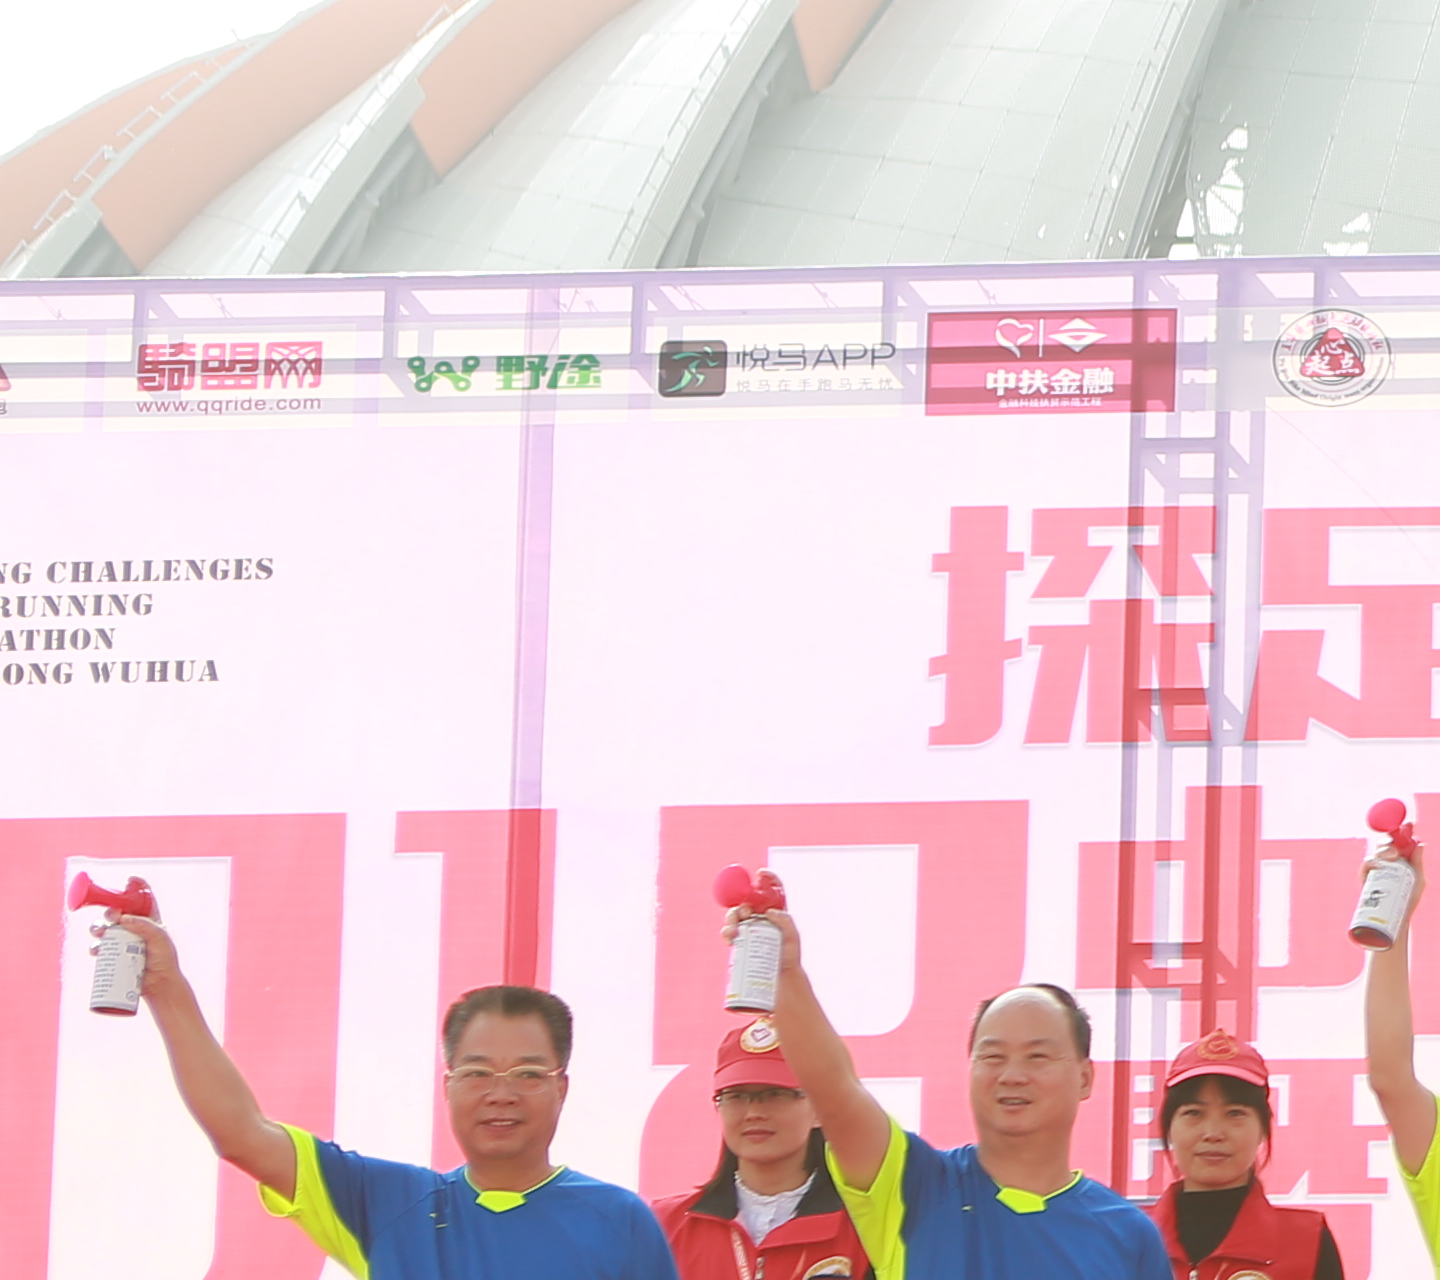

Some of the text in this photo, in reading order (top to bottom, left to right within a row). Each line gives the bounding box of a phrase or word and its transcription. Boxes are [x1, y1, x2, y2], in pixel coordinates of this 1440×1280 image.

[495, 354, 602, 391] 野途
[985, 367, 1116, 397] 中扶金融
[136, 395, 322, 414] www.qqride.com
[46, 557, 275, 585] CHALLENGES
[89, 659, 221, 685] WUHUA
